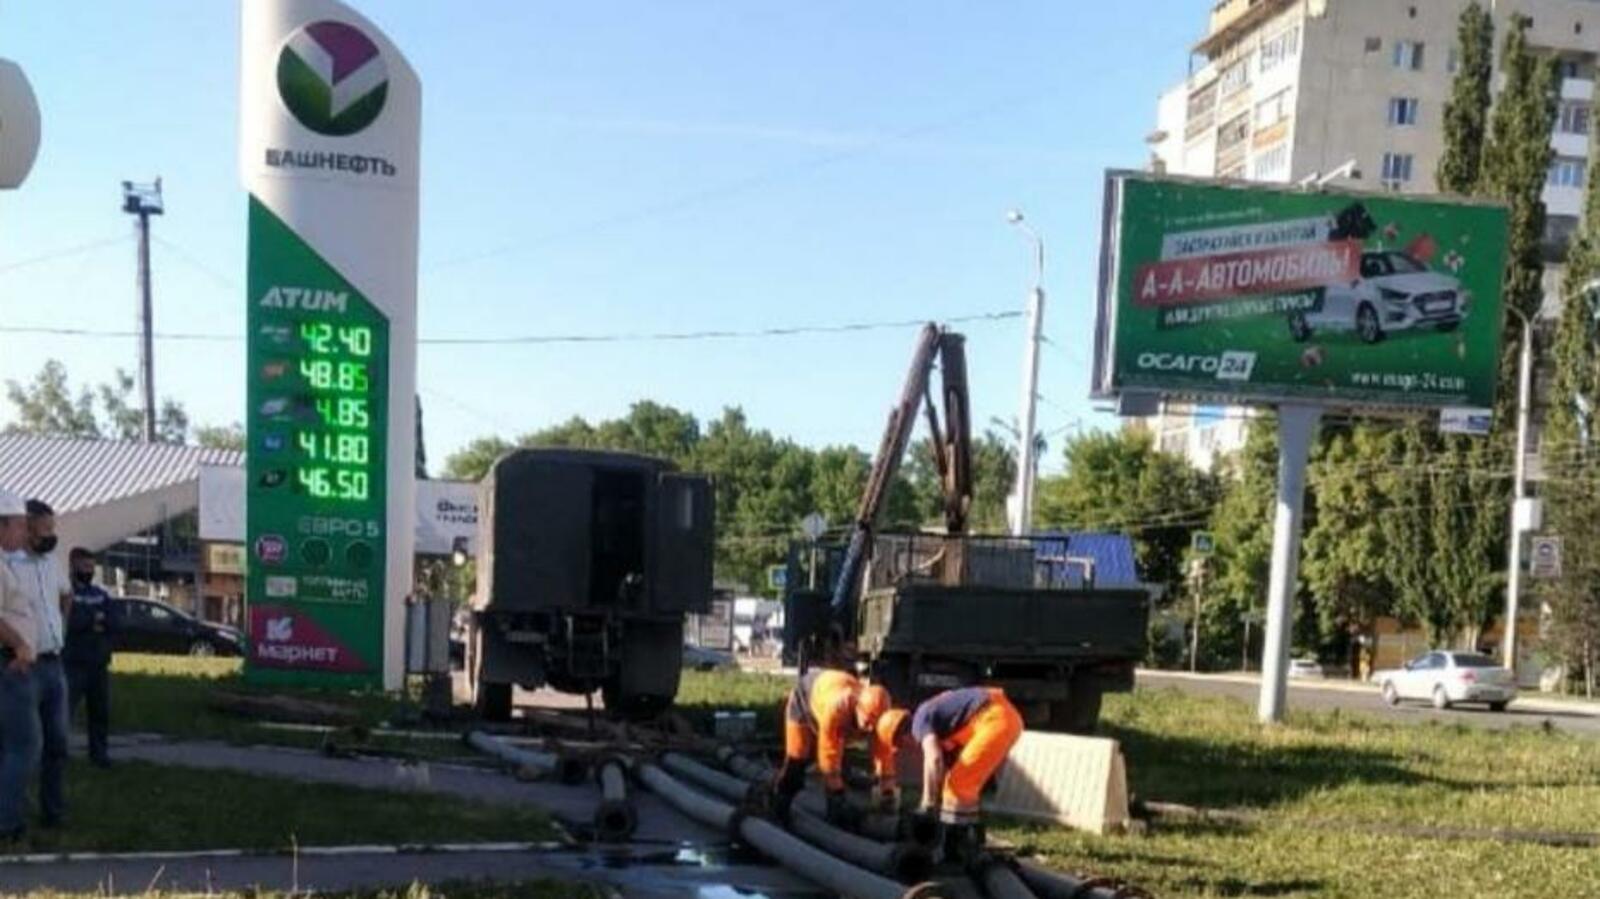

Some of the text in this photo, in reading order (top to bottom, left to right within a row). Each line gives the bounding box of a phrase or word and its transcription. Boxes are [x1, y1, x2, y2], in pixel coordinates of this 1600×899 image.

[265, 148, 397, 177] БАШНЕФТЬ
[301, 323, 371, 356] 42.40
[300, 360, 369, 392] 48.85
[300, 431, 369, 464] 41.80
[300, 468, 369, 500] 46.50
[367, 521, 380, 537] 5
